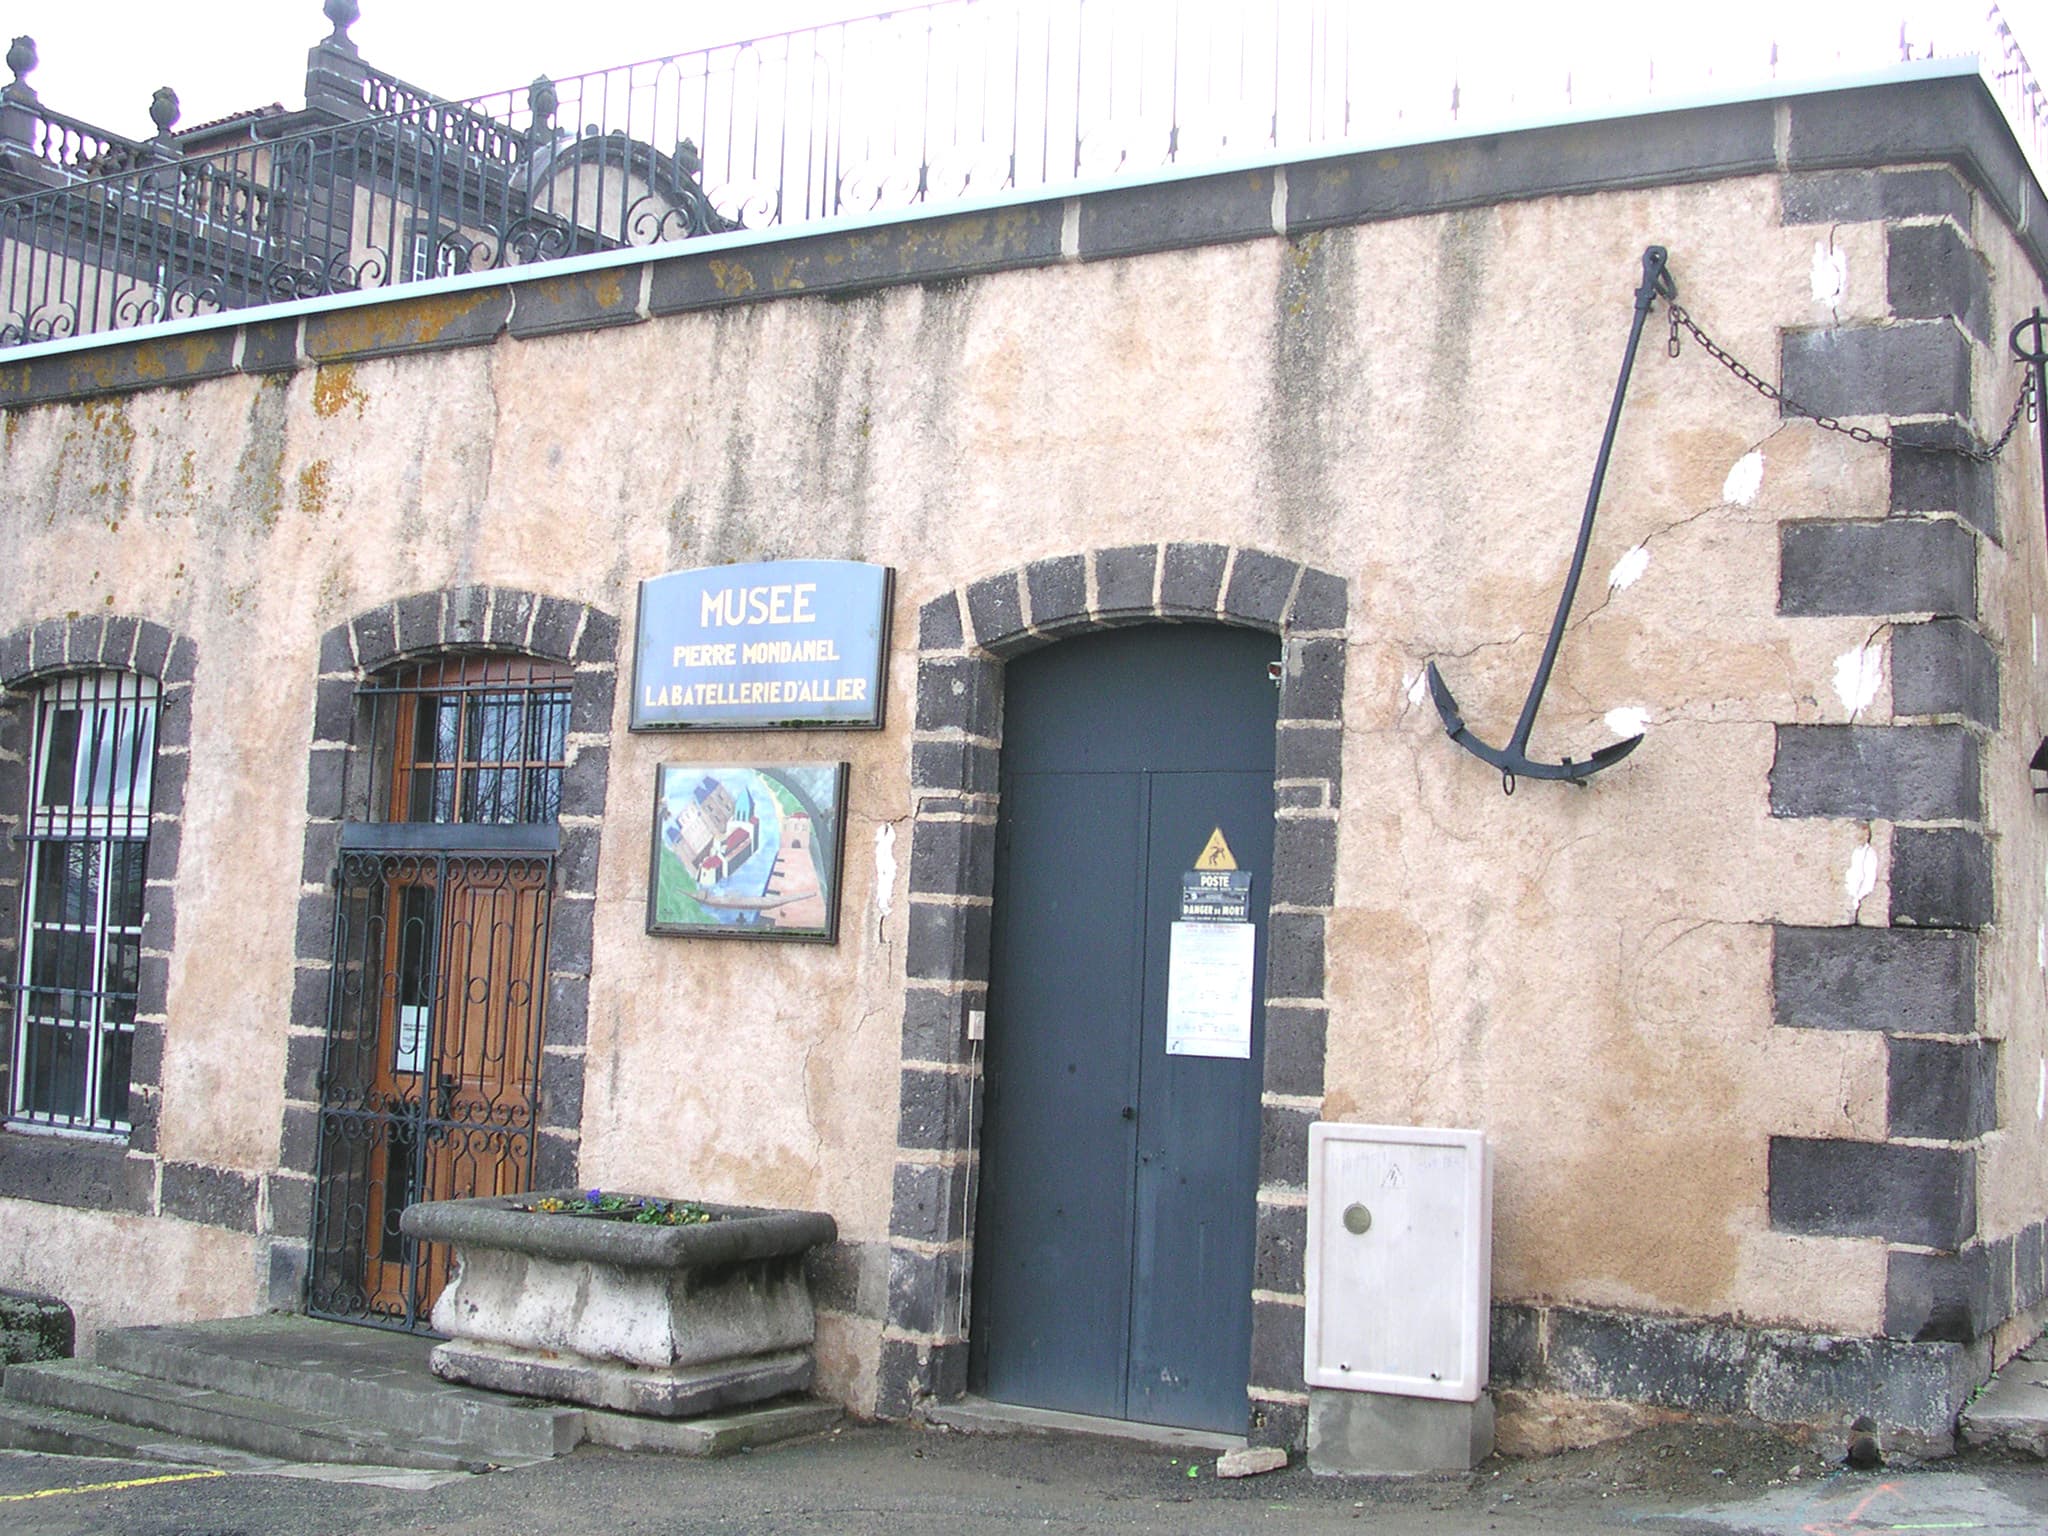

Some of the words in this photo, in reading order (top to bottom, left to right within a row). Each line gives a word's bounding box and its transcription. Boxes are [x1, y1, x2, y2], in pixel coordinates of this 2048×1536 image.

[700, 583, 817, 628] MUSEE
[672, 643, 737, 668] PIERRE
[742, 639, 840, 665] MONDANEL
[1200, 875, 1230, 888] POSTE
[1183, 904, 1213, 915] DANGER
[1222, 905, 1245, 916] MORT
